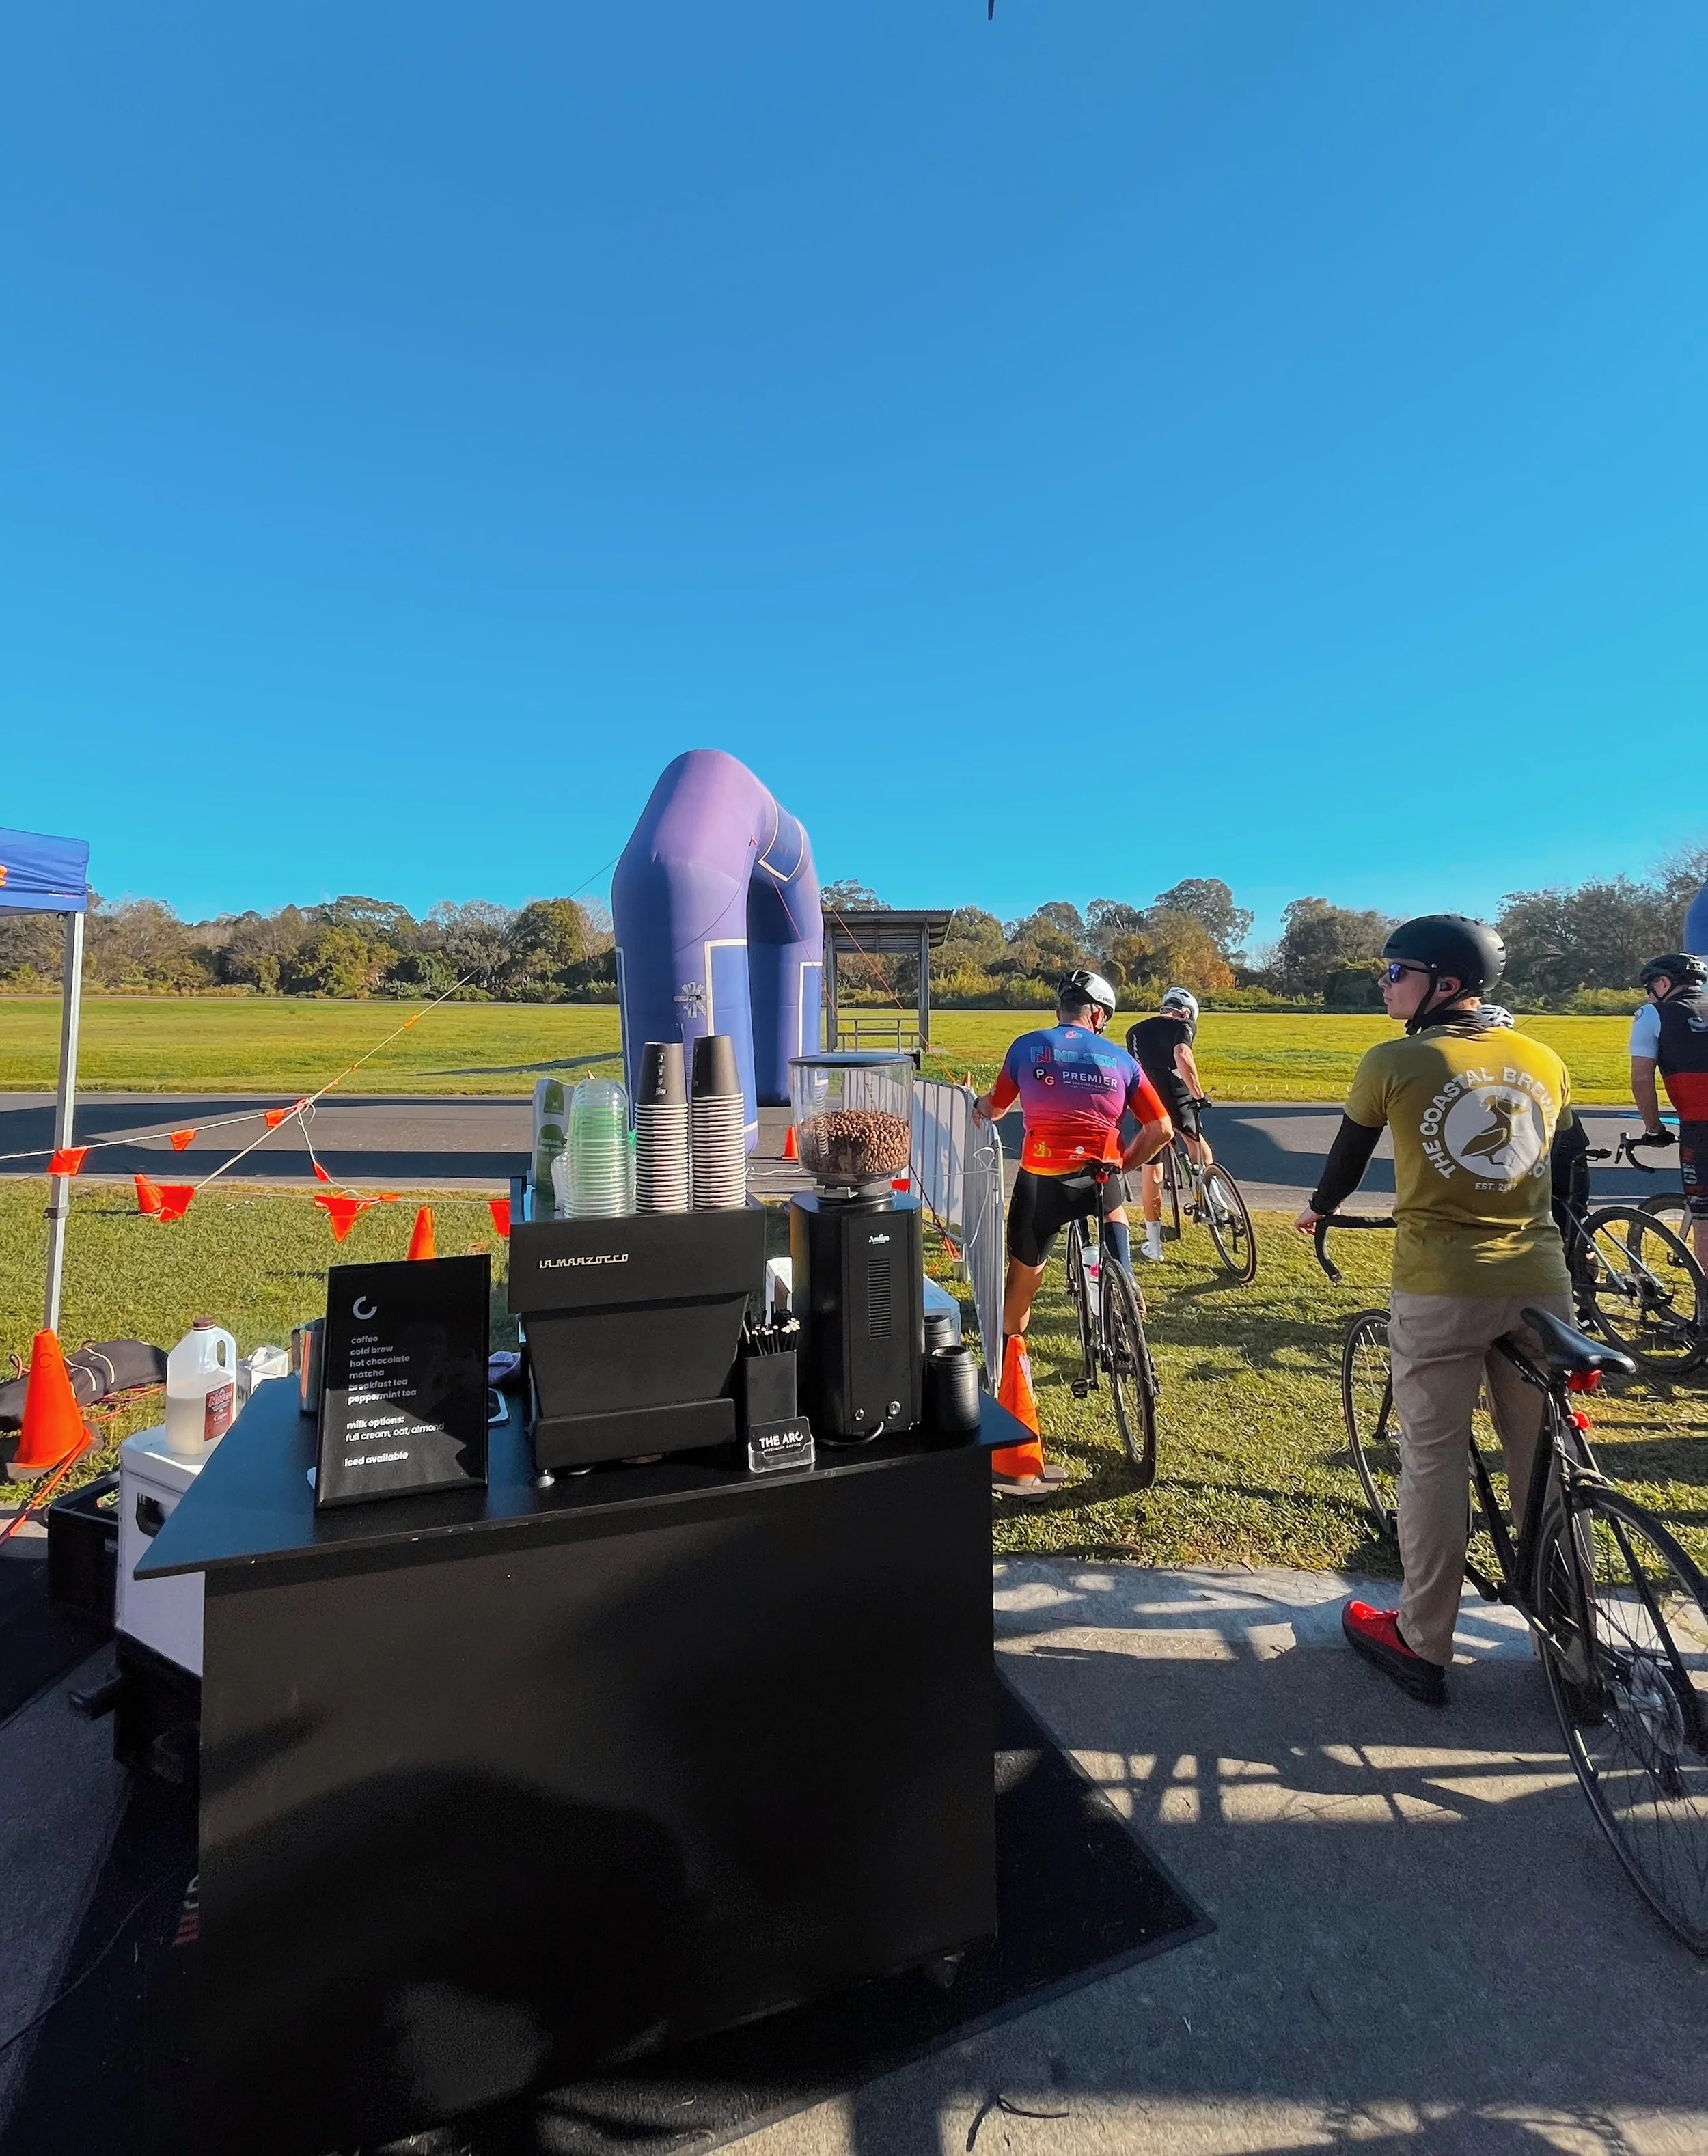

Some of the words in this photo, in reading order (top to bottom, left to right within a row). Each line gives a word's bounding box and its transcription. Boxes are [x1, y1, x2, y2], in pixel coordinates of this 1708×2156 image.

[1053, 1049, 1117, 1070] NILSEN
[1062, 1070, 1118, 1088] PREMIER
[1420, 1066, 1495, 1136] COASTAL
[1422, 1139, 1457, 1180] THE
[1475, 1182, 1495, 1191] EST.
[351, 1336, 378, 1344] coffee
[350, 1347, 370, 1356] cold
[350, 1359, 364, 1367] hot
[366, 1355, 410, 1366] chocolate
[349, 1369, 384, 1379] matcha
[348, 1380, 391, 1391] breakfast
[348, 1390, 401, 1405] peppermint
[346, 1420, 368, 1430] milk
[368, 1416, 404, 1429] options:
[346, 1433, 359, 1442] full
[361, 1430, 392, 1440] cream,
[393, 1427, 410, 1436] oat,
[411, 1422, 445, 1434] almond
[758, 1435, 780, 1448] THE
[782, 1431, 803, 1445] ARC
[344, 1456, 365, 1467] iced
[366, 1451, 409, 1464] available
